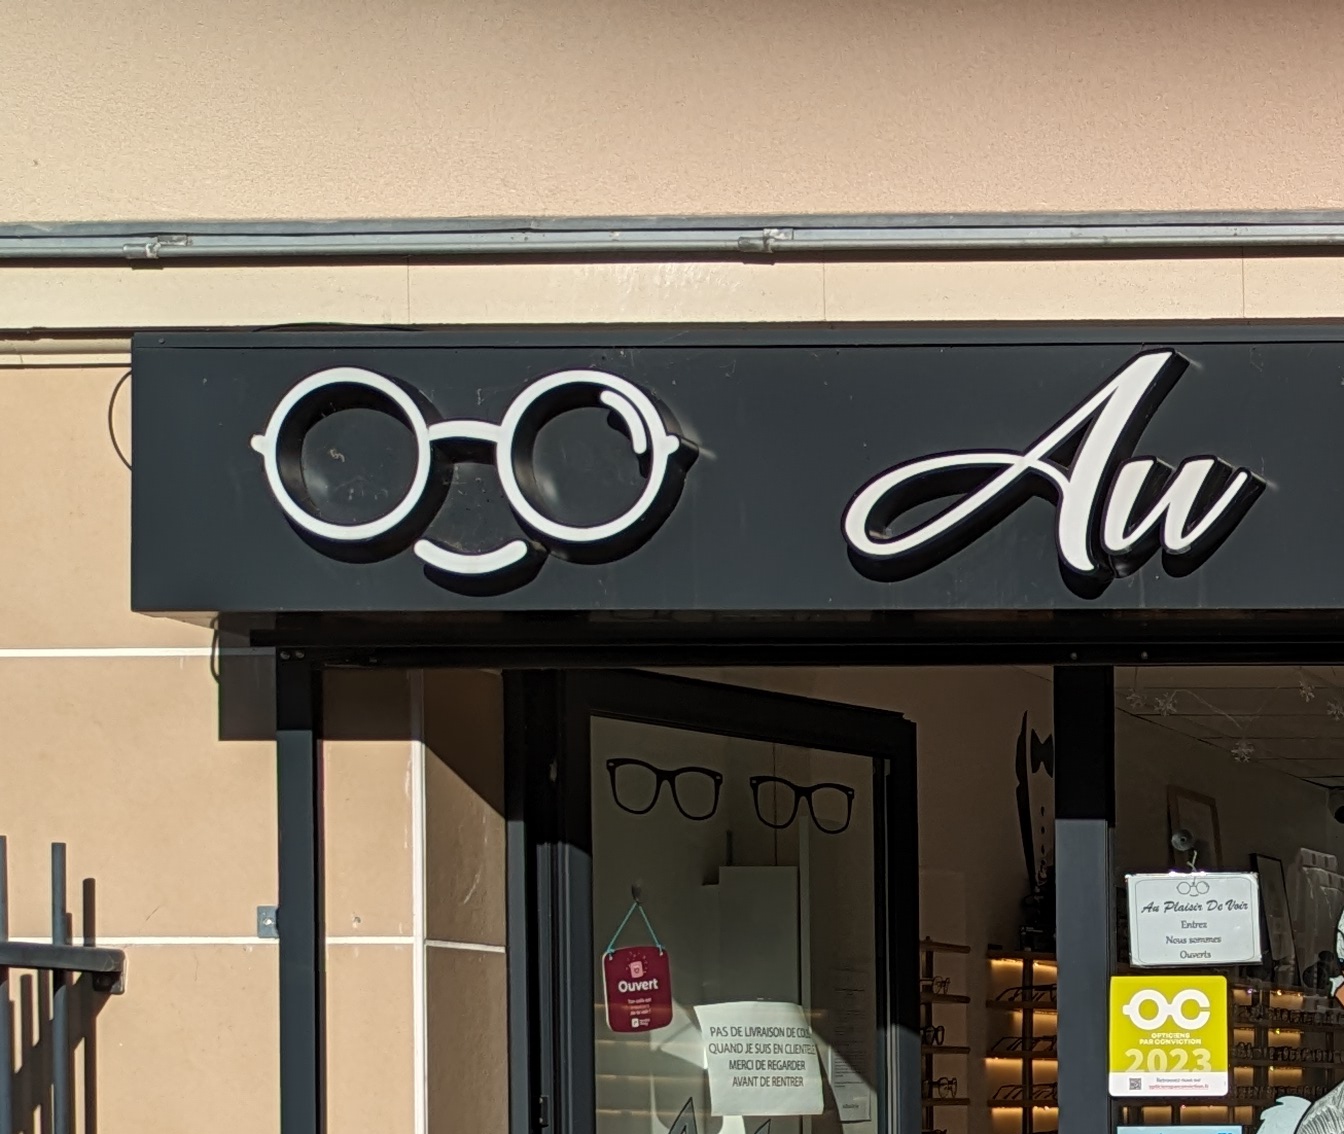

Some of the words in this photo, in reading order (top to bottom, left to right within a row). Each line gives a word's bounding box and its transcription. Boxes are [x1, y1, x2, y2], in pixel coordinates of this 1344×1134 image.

[842, 348, 1255, 572] Au
[1141, 901, 1160, 913] Au
[1163, 900, 1203, 913] Plaisir
[1206, 900, 1223, 911] De
[1225, 899, 1248, 911] Voir
[1180, 921, 1208, 929] Entrez
[1165, 936, 1187, 945] Nous
[1189, 936, 1221, 944] sommes
[1179, 951, 1212, 959] Ouverts
[618, 978, 659, 992] Ouvert
[710, 1026, 729, 1037] PAS
[730, 1026, 744, 1037] DE
[744, 1027, 785, 1038] LIVRAISON
[786, 1027, 796, 1038] DE
[708, 1043, 744, 1055] QUAND
[745, 1043, 754, 1055] JE
[755, 1044, 772, 1055] SUIS
[774, 1044, 784, 1055] EN
[728, 1060, 754, 1071] MERCI
[755, 1060, 767, 1071] DE
[767, 1060, 806, 1071] REGARDER
[1125, 1048, 1212, 1073] 2023
[732, 1076, 758, 1087] AVANT
[759, 1076, 771, 1087] DE
[771, 1076, 804, 1087] RENTRER
